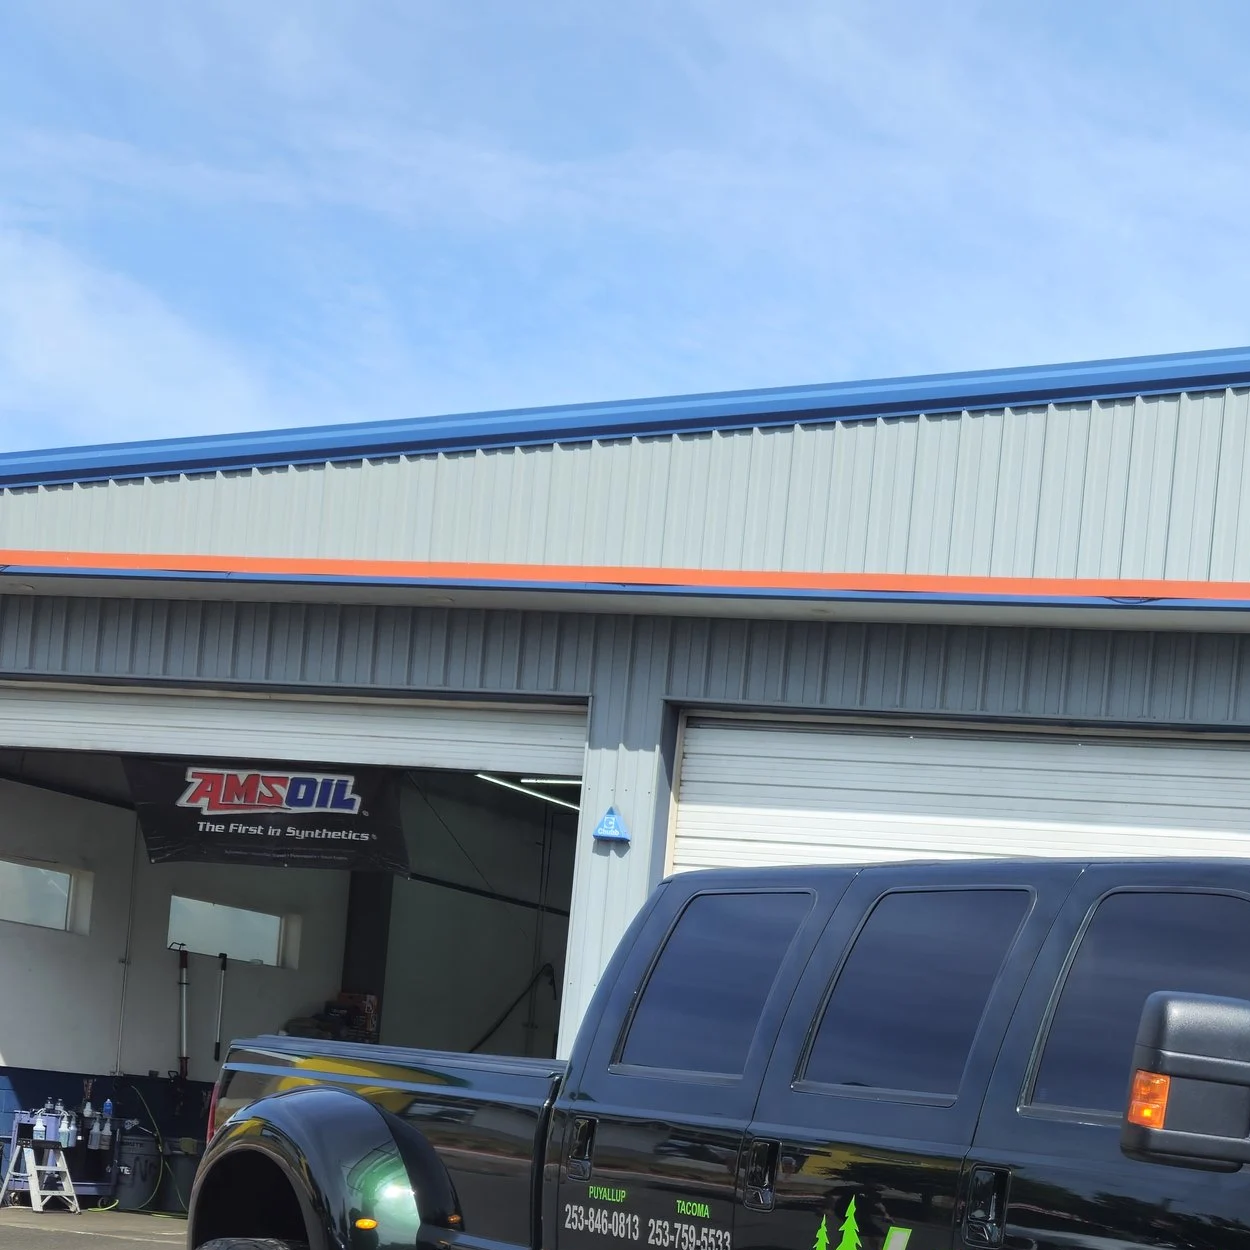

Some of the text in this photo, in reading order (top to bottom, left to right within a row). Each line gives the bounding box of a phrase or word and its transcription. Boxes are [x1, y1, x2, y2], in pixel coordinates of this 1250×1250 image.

[178, 769, 361, 815] AMSOIL
[197, 821, 369, 841] The First in Synthetics
[589, 1185, 627, 1203] PUYALLUP
[676, 1200, 710, 1218] TACOMA
[564, 1203, 640, 1241] 253-846-0813
